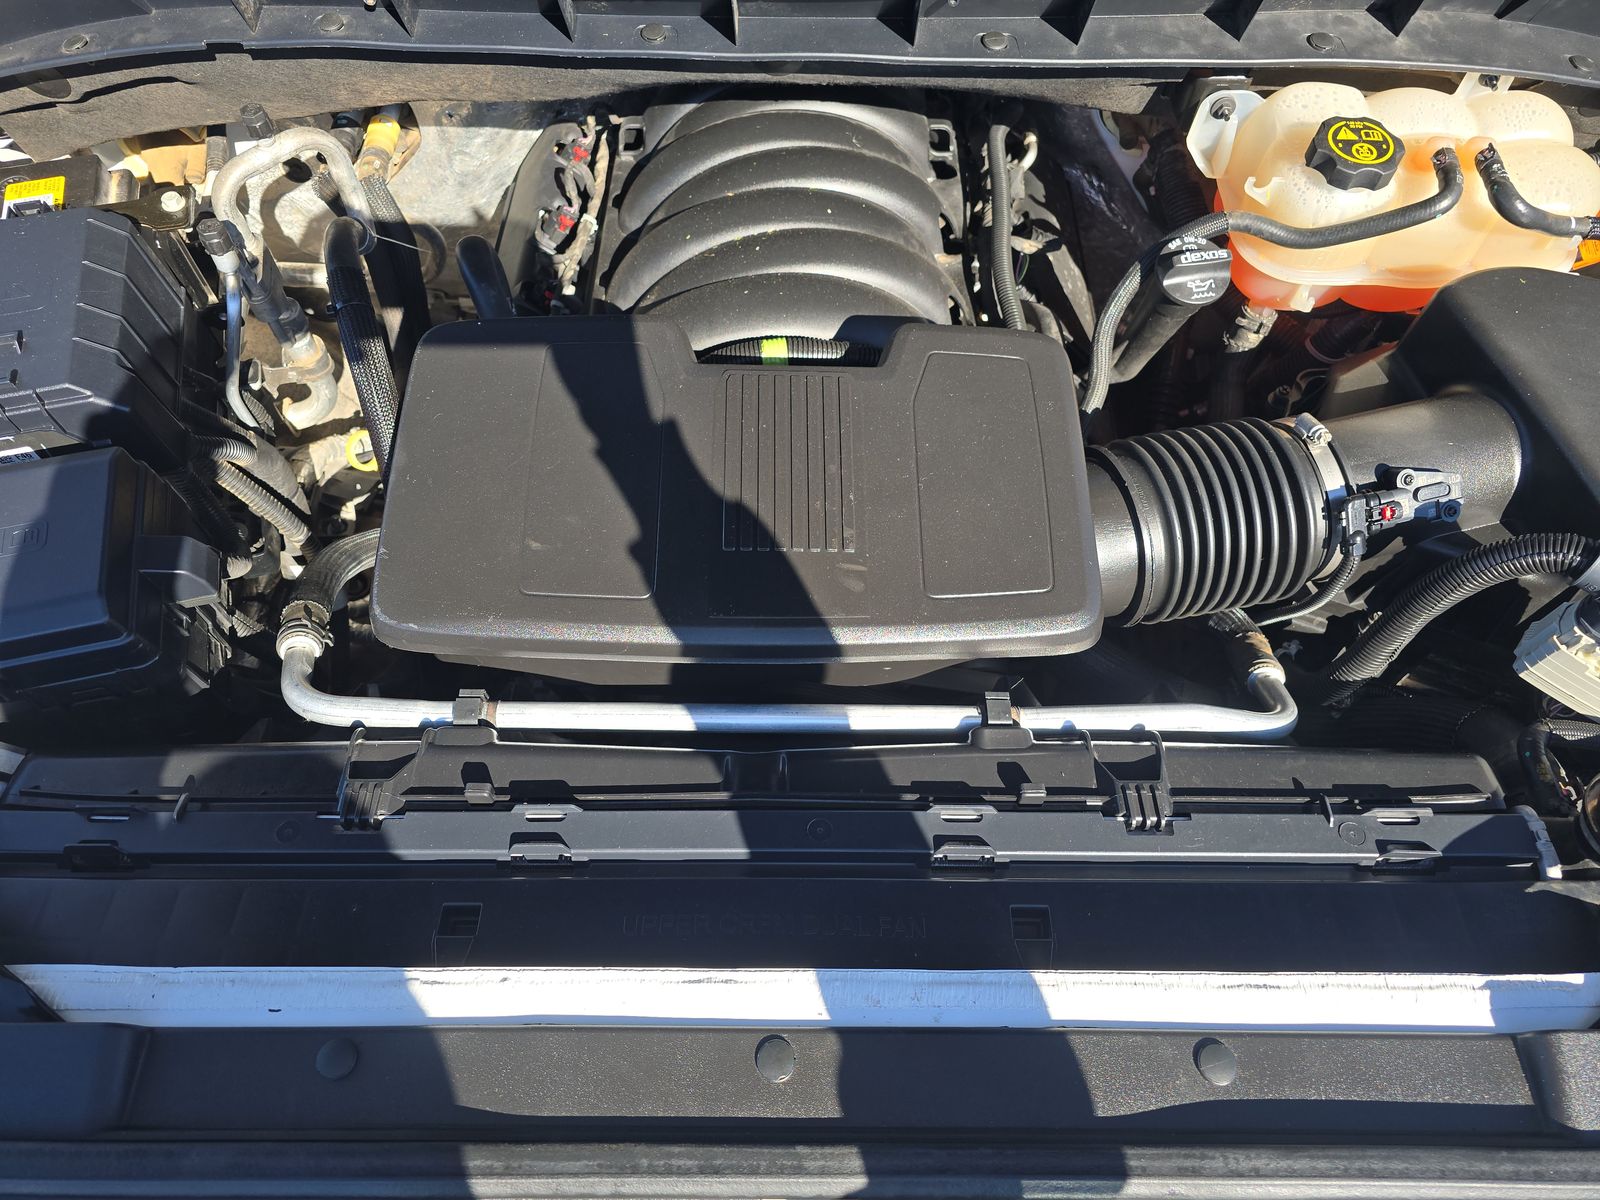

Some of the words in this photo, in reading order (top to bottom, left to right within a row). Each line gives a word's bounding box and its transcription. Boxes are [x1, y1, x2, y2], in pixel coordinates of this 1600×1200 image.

[1168, 238, 1182, 249] SAE
[1181, 249, 1228, 264] dexos
[622, 914, 714, 937] UPPER
[801, 914, 871, 937] DUAL
[878, 914, 928, 938] FAN
